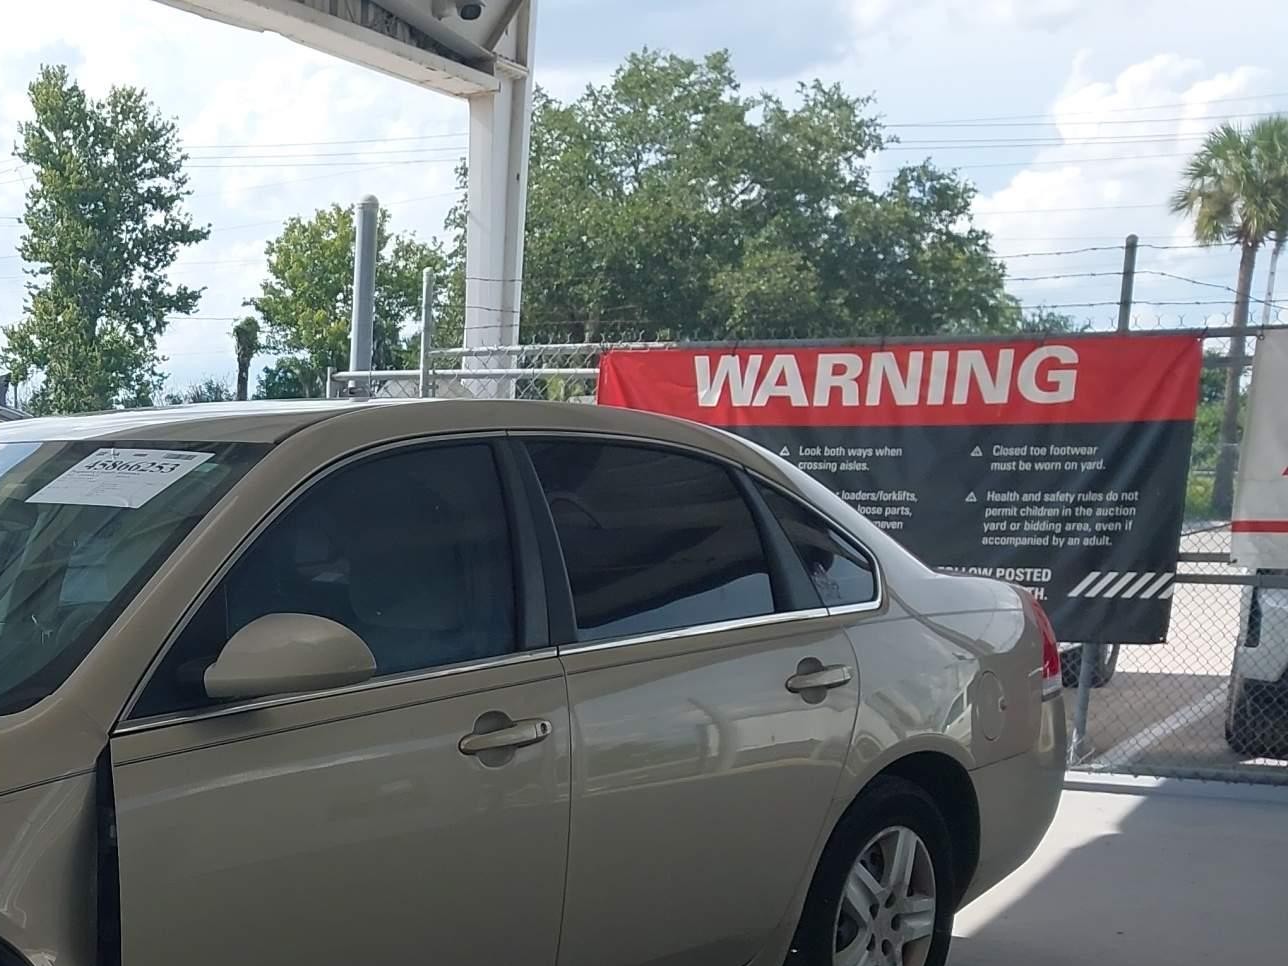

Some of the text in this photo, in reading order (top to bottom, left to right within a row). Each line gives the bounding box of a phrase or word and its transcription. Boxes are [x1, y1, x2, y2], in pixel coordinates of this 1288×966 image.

[694, 345, 1080, 407] WARNING
[799, 446, 902, 458] Look both ways when
[992, 445, 1098, 456] Closed toe footwear
[85, 460, 180, 473] 45866253
[798, 460, 869, 472] crossing aisles.
[990, 459, 1106, 473] must be worn on yard.
[841, 490, 918, 502] loaders/forklifts,
[987, 491, 1139, 503] Health and safety rules do not
[858, 504, 912, 517] loose parts,
[985, 506, 1136, 518] permit children in the auction
[872, 520, 903, 529] neven
[983, 520, 1133, 533] yard or bidding area, even if
[982, 535, 1112, 547] accompanied by an adult.
[996, 567, 1052, 582] POSTED
